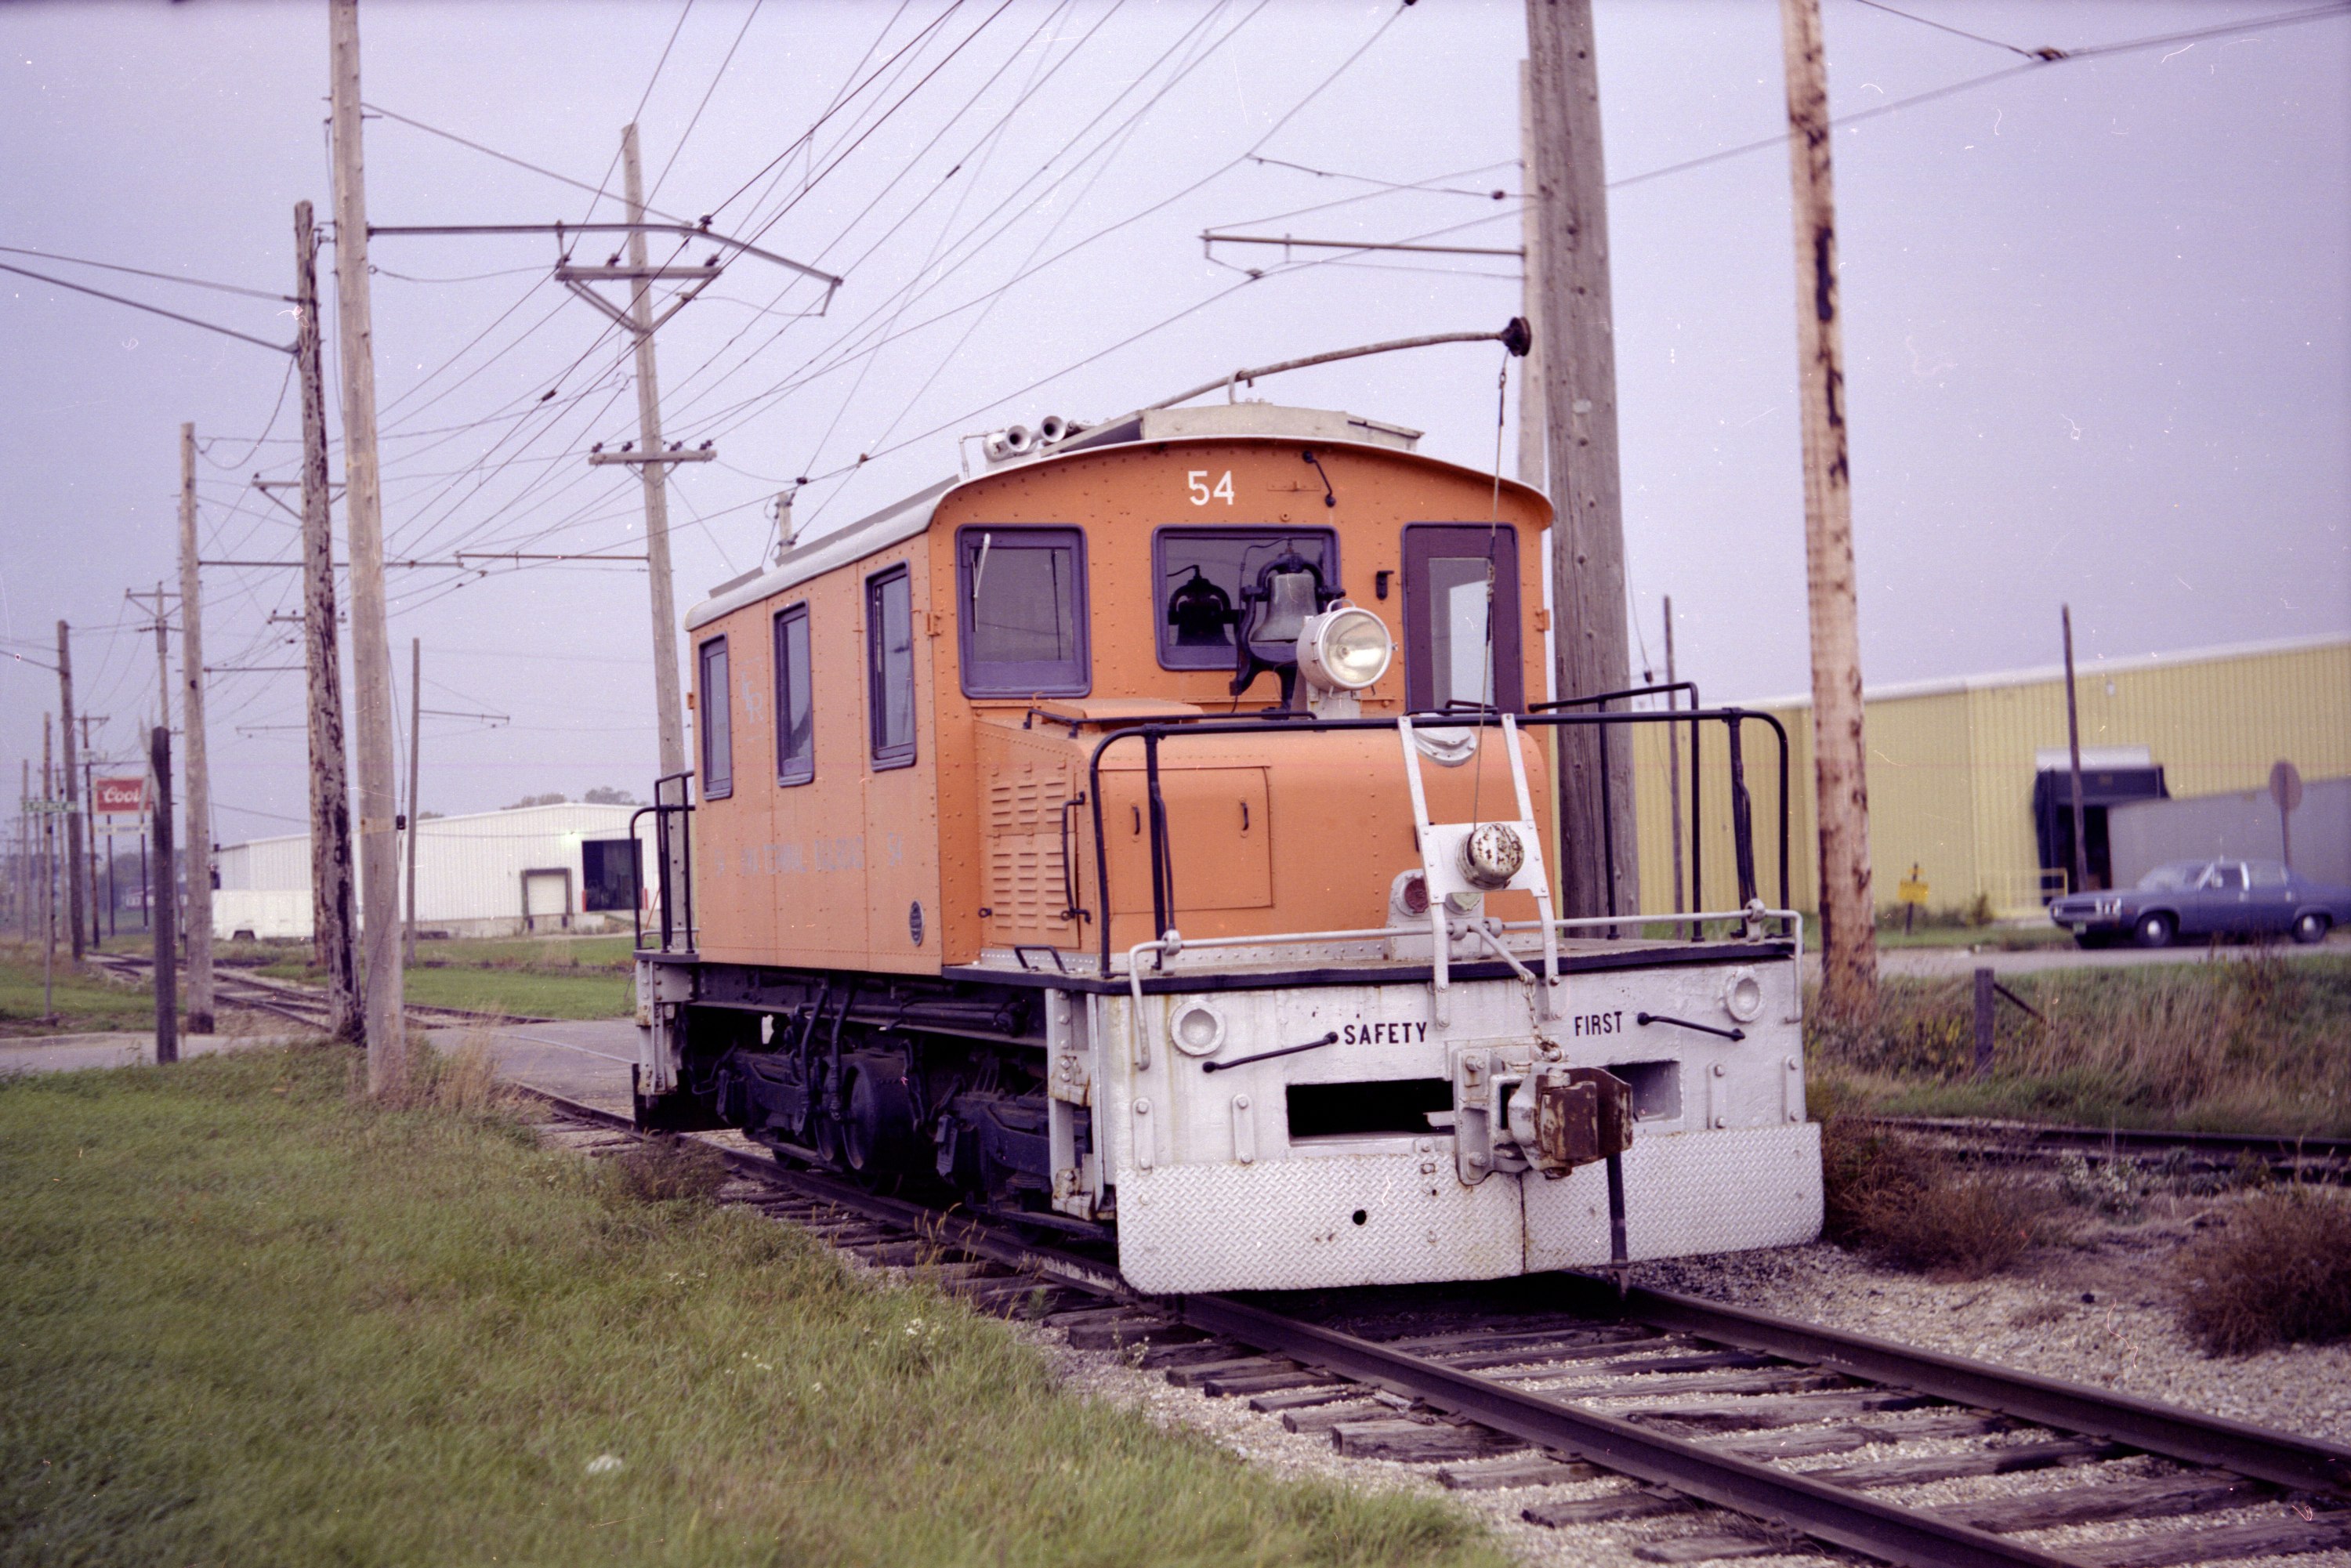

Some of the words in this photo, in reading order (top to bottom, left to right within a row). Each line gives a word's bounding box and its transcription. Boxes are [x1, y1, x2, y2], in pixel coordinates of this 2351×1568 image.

[1187, 469, 1235, 506] 54
[1343, 1021, 1427, 1045] SAFETY
[1574, 1011, 1622, 1036] FIRST
